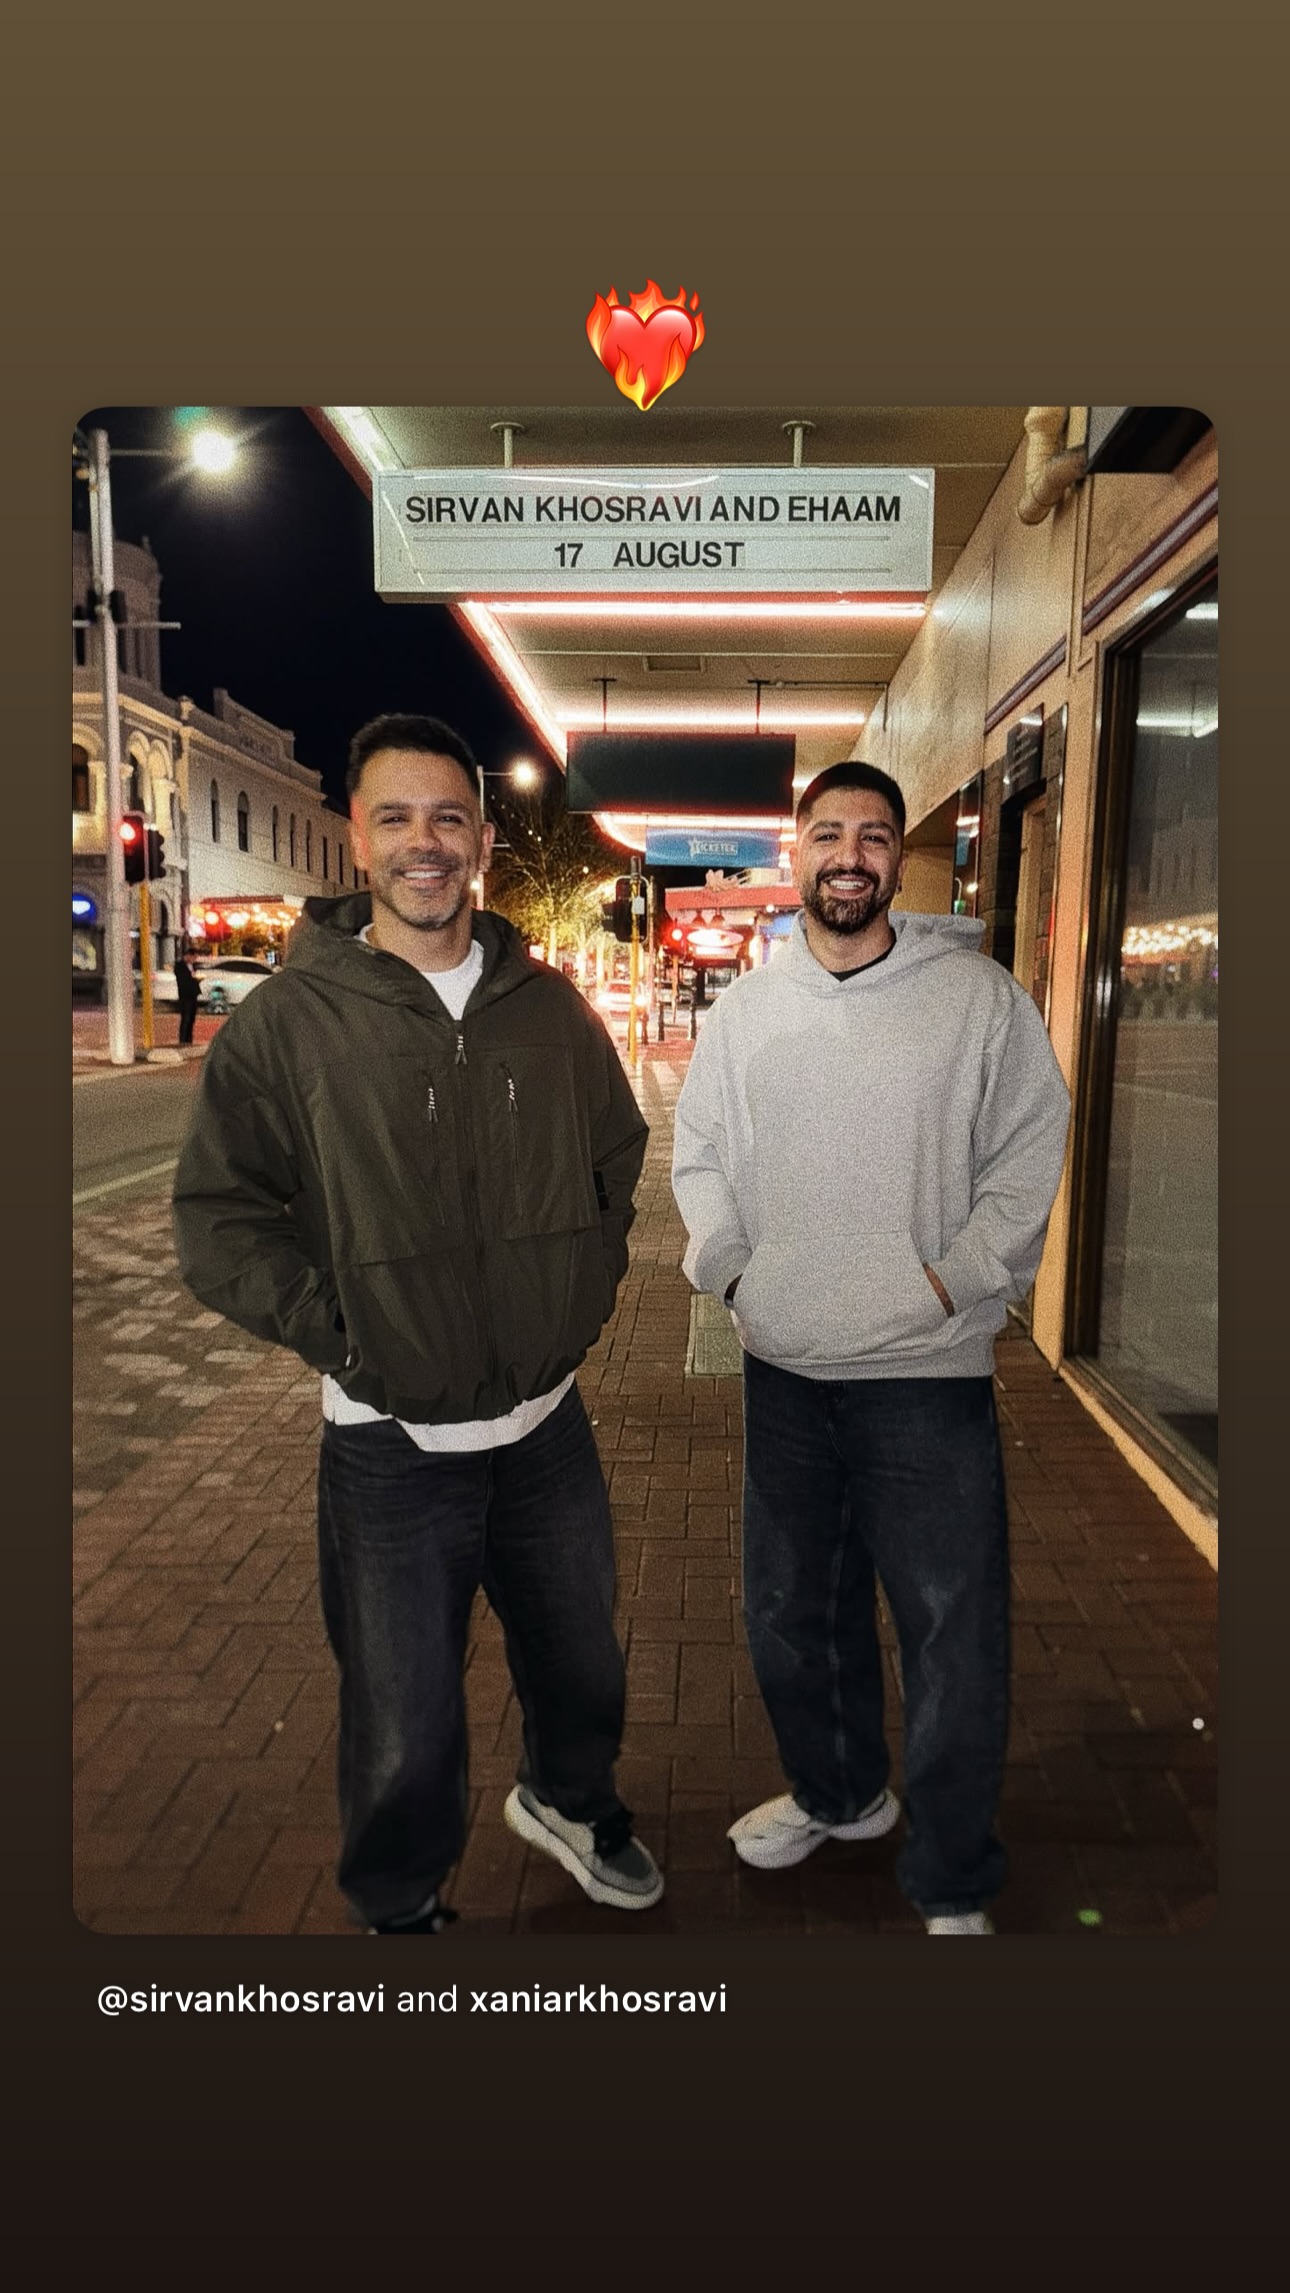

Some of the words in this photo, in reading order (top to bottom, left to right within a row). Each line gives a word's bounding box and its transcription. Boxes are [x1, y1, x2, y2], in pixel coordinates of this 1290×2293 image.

[405, 496, 524, 524] SIRVAN
[536, 496, 701, 523] KHOSRAVI
[709, 495, 780, 523] AND
[788, 495, 901, 523] EHAAM
[554, 542, 584, 568] 17
[613, 541, 745, 569] AUGUST
